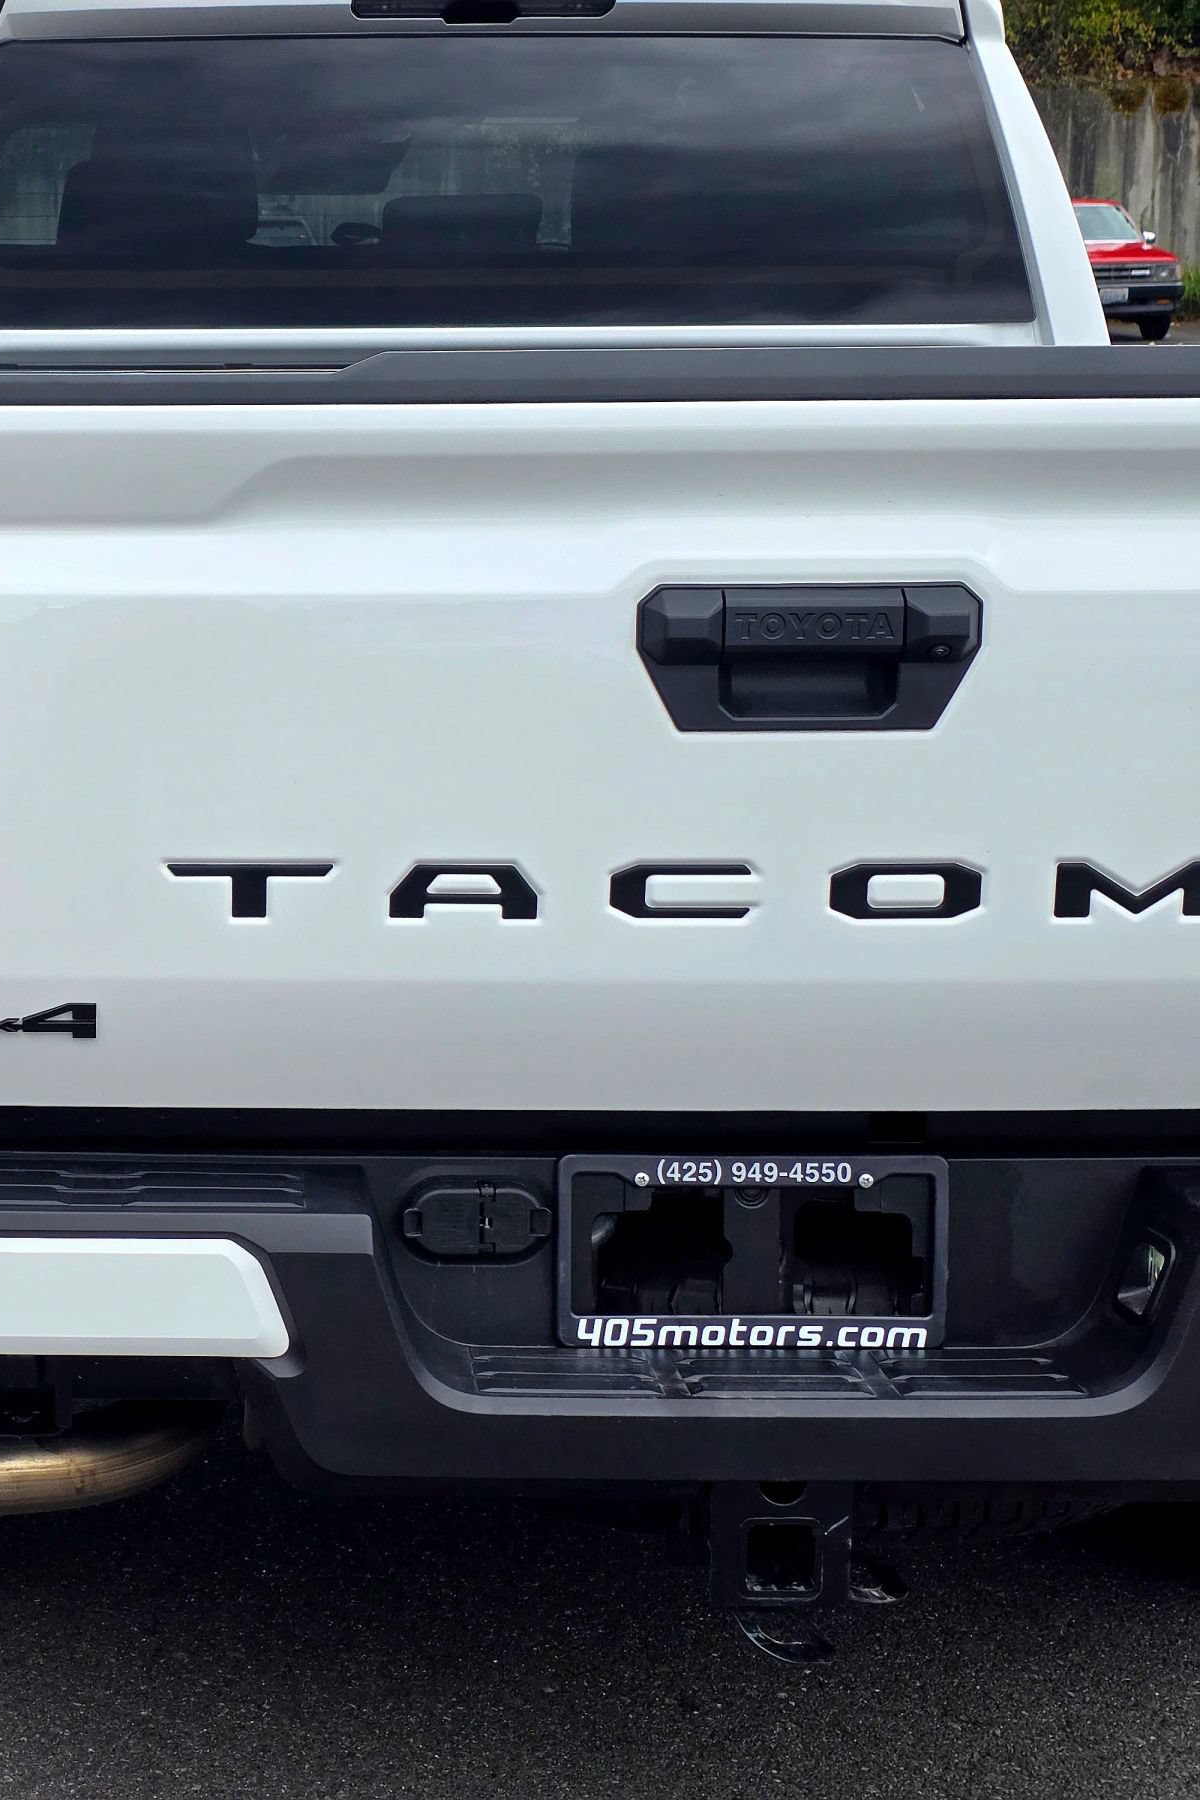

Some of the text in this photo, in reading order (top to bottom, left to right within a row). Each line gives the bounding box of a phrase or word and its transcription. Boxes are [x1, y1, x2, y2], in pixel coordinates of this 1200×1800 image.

[736, 612, 895, 641] TOYOTA
[166, 861, 1200, 919] TACOM
[657, 1160, 852, 1184] (425) 949-4550
[577, 1318, 928, 1347] 405motors.com
